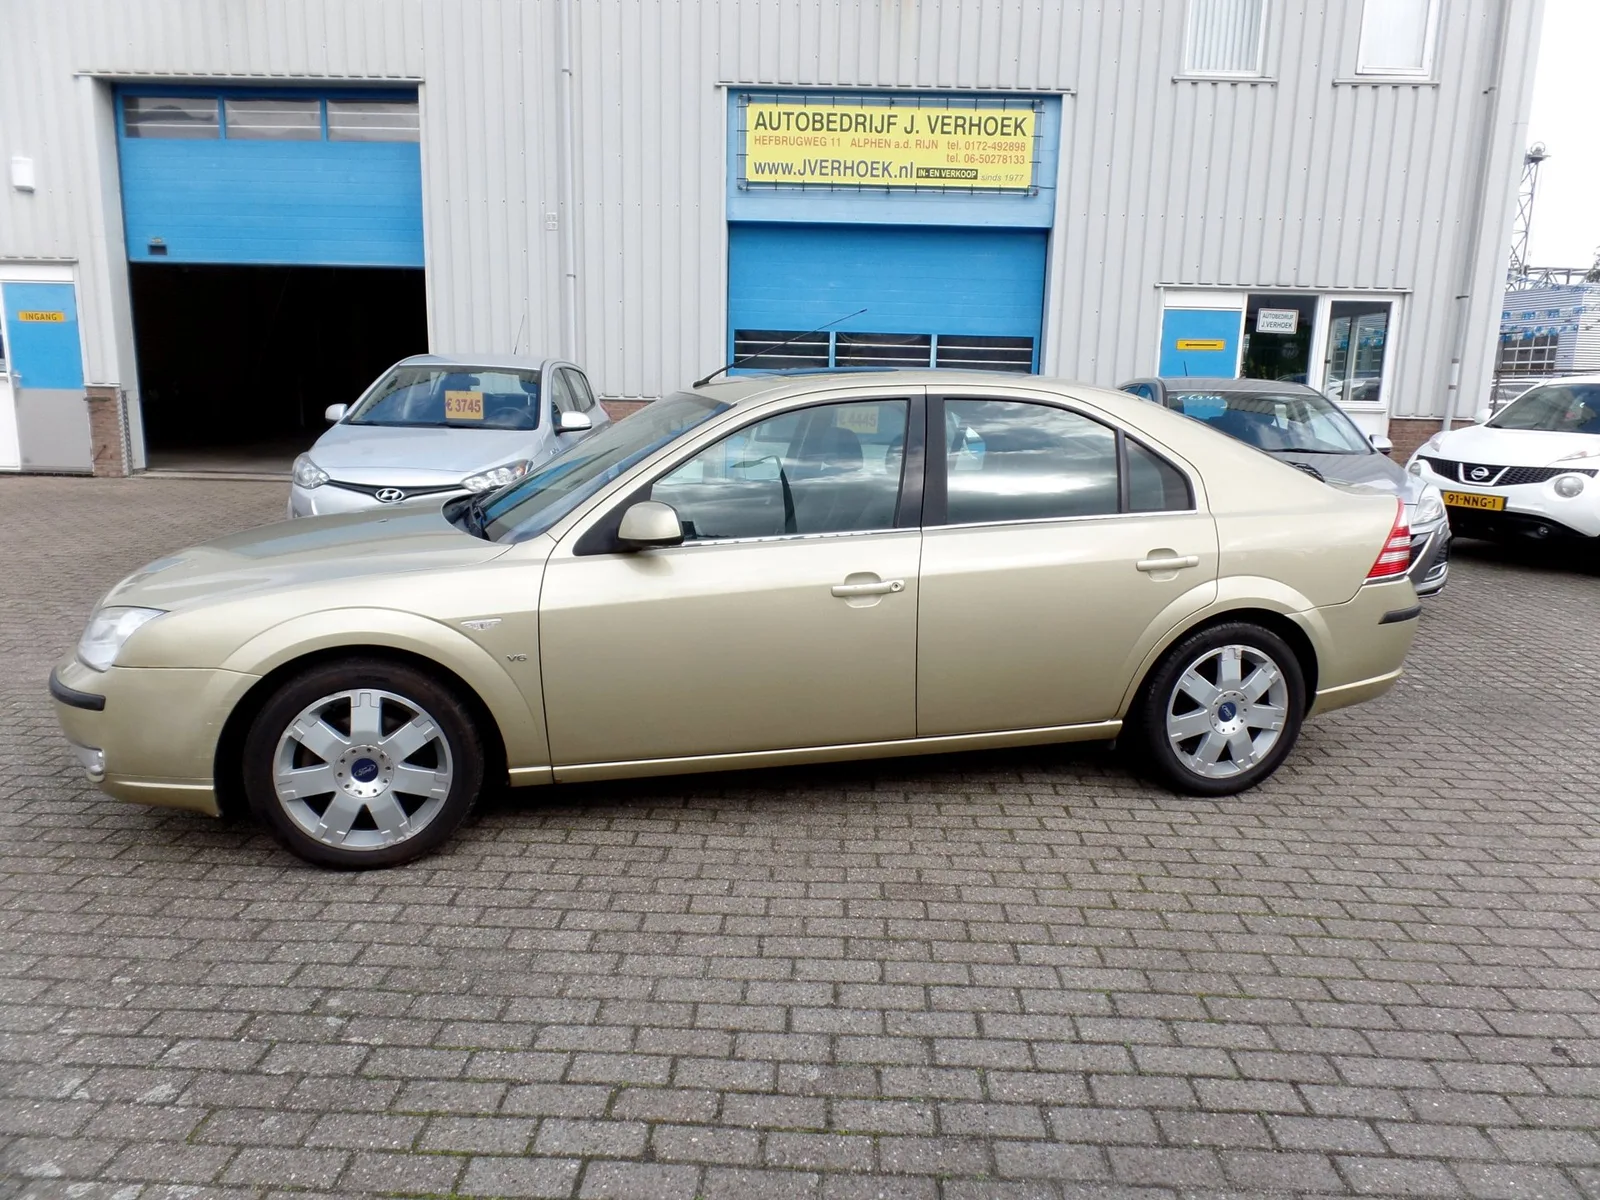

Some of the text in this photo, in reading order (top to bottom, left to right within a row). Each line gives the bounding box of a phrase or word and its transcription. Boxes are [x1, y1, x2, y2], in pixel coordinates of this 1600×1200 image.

[754, 110, 1027, 137] AUTOBEDRIJF J. VERHOEK
[754, 135, 1026, 152] HEFBRUGWEG 11 ALPHEN a.d. RIJN tel. 0172-492898
[946, 153, 1025, 165] tel. 06-50278133
[754, 158, 913, 179] www.JVERHOEK.nl
[930, 169, 940, 178] EN
[941, 169, 977, 179] VERKOOP
[980, 172, 1025, 182] sinds 1977
[25, 312, 57, 321] INGANG
[446, 398, 481, 413] € 3745
[1448, 493, 1496, 509] 91-NNG-1
[506, 653, 527, 662] V6
